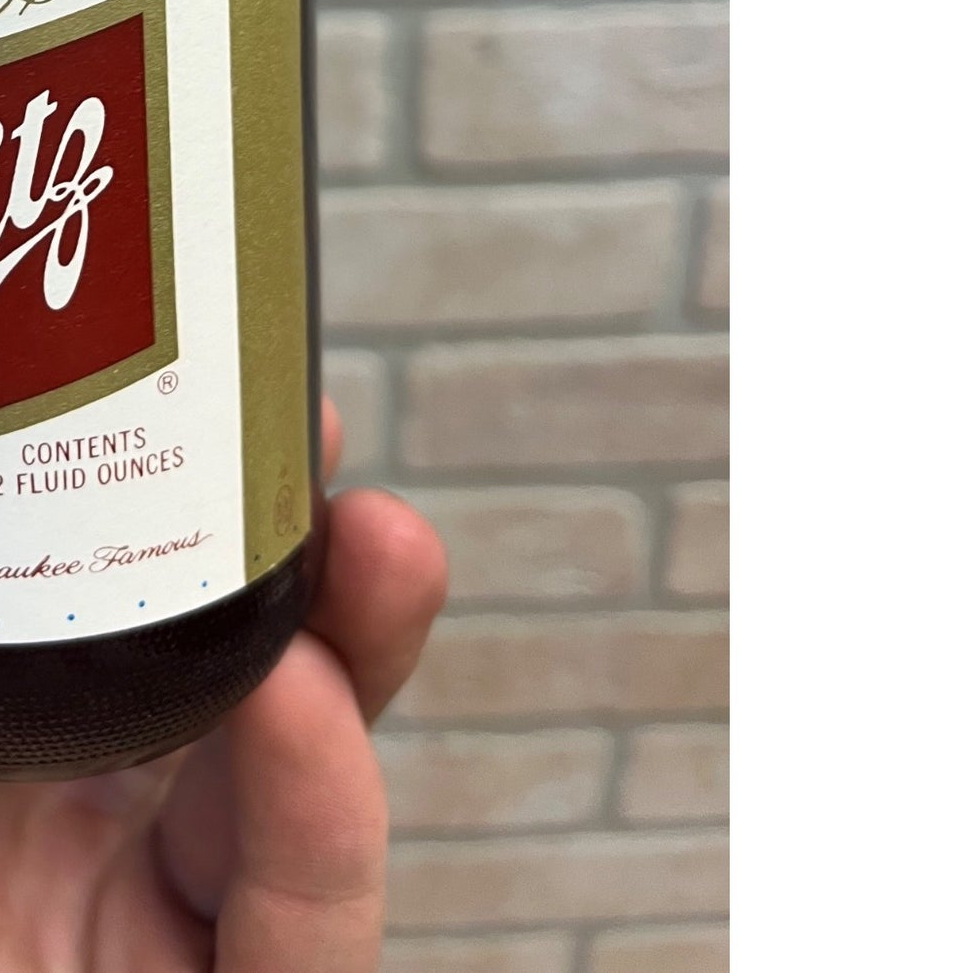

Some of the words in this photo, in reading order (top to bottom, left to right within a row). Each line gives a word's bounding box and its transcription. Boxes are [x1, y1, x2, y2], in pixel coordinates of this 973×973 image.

[21, 427, 146, 466] CONTENTS
[16, 467, 87, 496] FLUID
[97, 445, 185, 486] OUNCES
[89, 529, 214, 573] Famous
